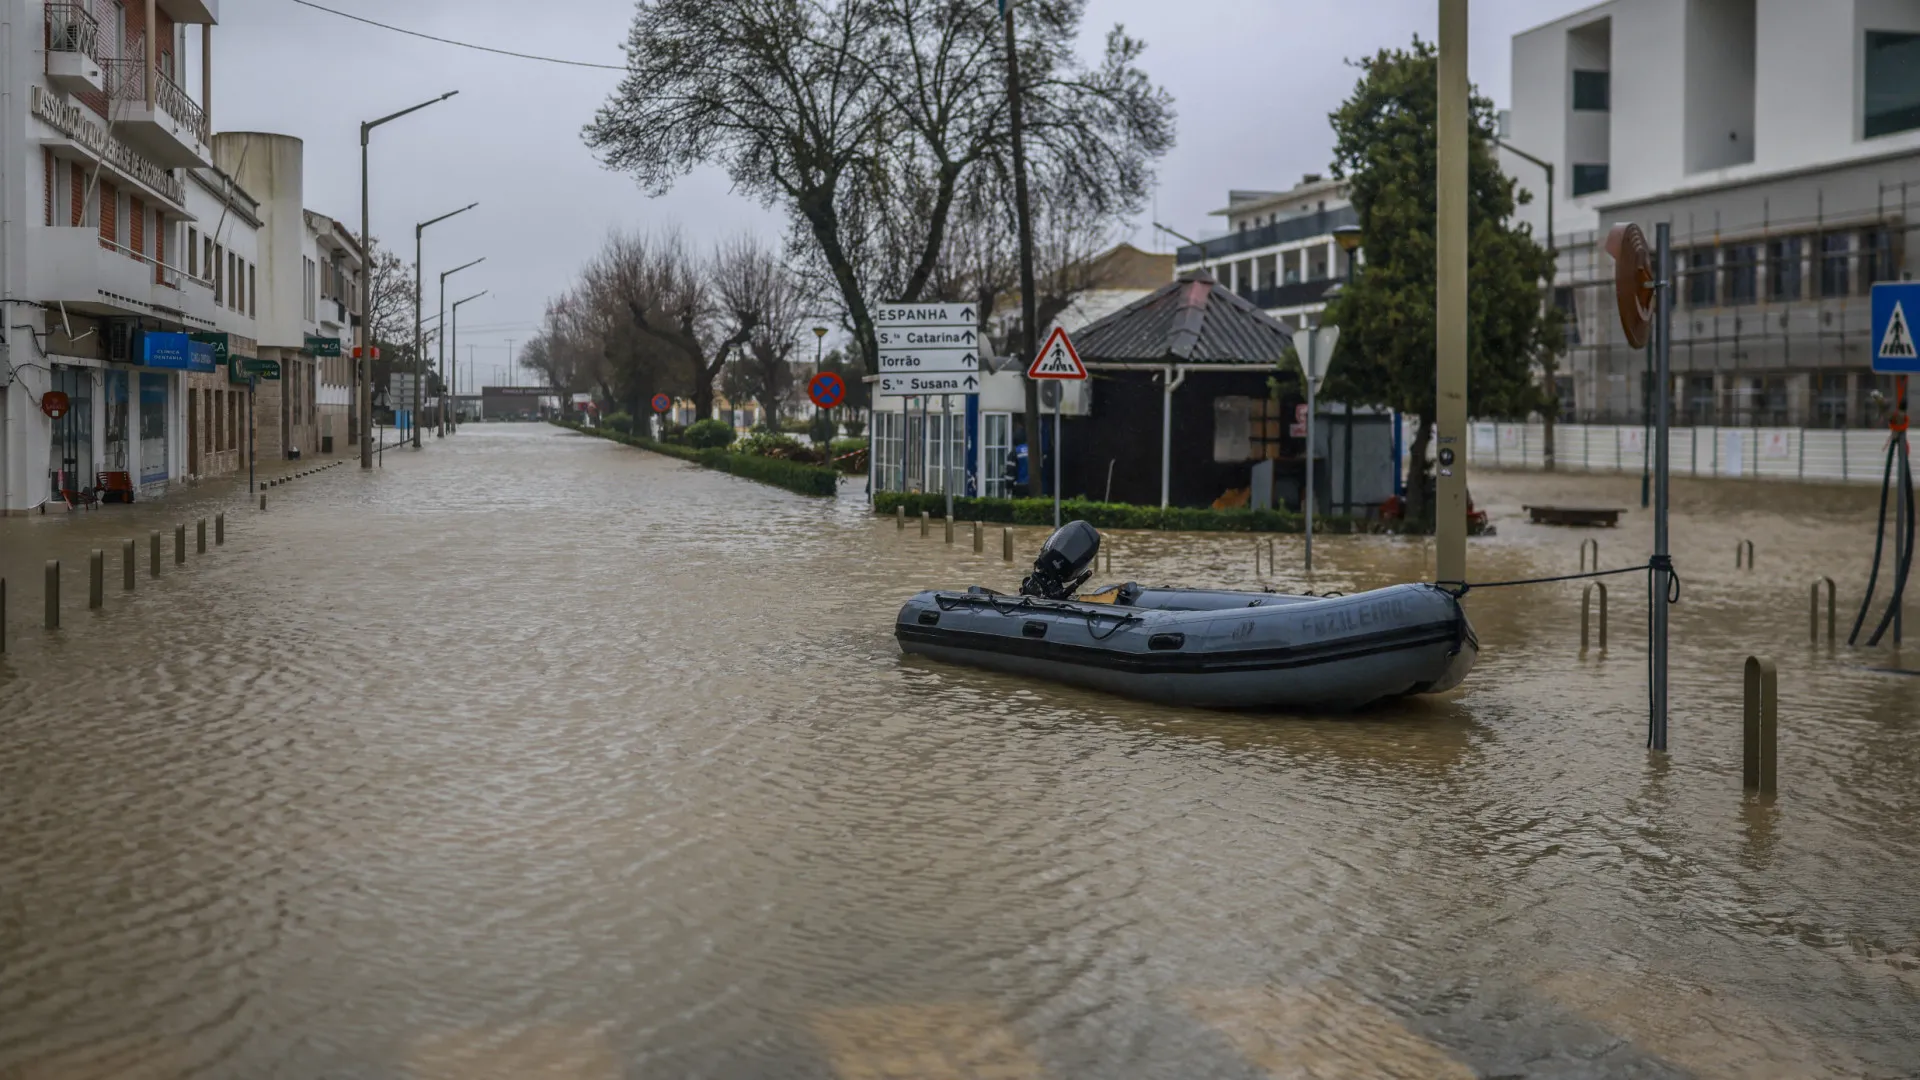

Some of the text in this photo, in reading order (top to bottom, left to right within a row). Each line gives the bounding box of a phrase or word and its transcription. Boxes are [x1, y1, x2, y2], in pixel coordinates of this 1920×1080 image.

[878, 309, 948, 321] ESPANHA
[907, 332, 960, 344] Catarina
[880, 355, 920, 367] Torrão
[911, 378, 958, 390] Susana
